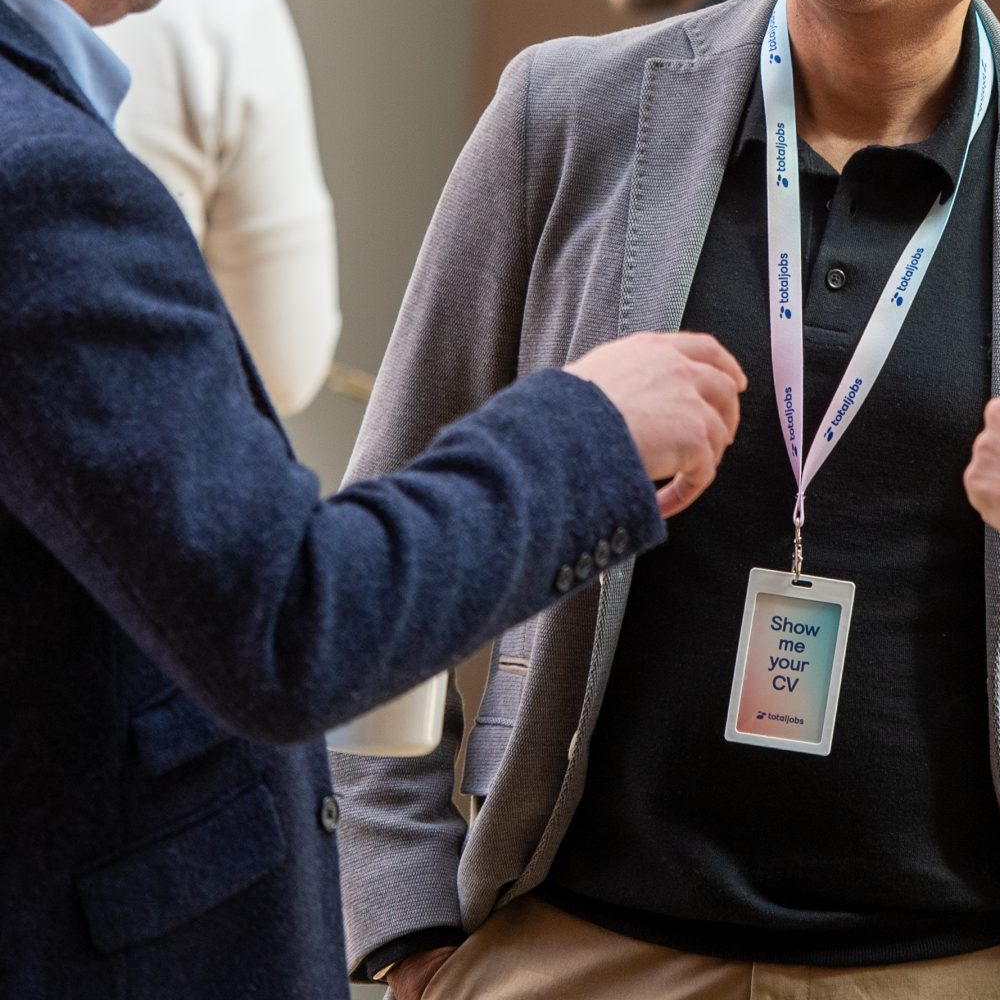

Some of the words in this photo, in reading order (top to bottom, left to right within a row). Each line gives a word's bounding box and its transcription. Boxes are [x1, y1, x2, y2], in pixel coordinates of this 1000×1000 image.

[776, 122, 788, 172] totaljobs
[778, 252, 792, 304] totaljobs
[900, 247, 925, 292] totaljobs
[784, 387, 796, 441] totaljobs
[832, 377, 863, 427] totaljobs
[770, 615, 820, 637] Show
[778, 638, 806, 653] me
[768, 655, 810, 673] your
[772, 675, 799, 692] CV
[767, 712, 804, 725] totaljobs
